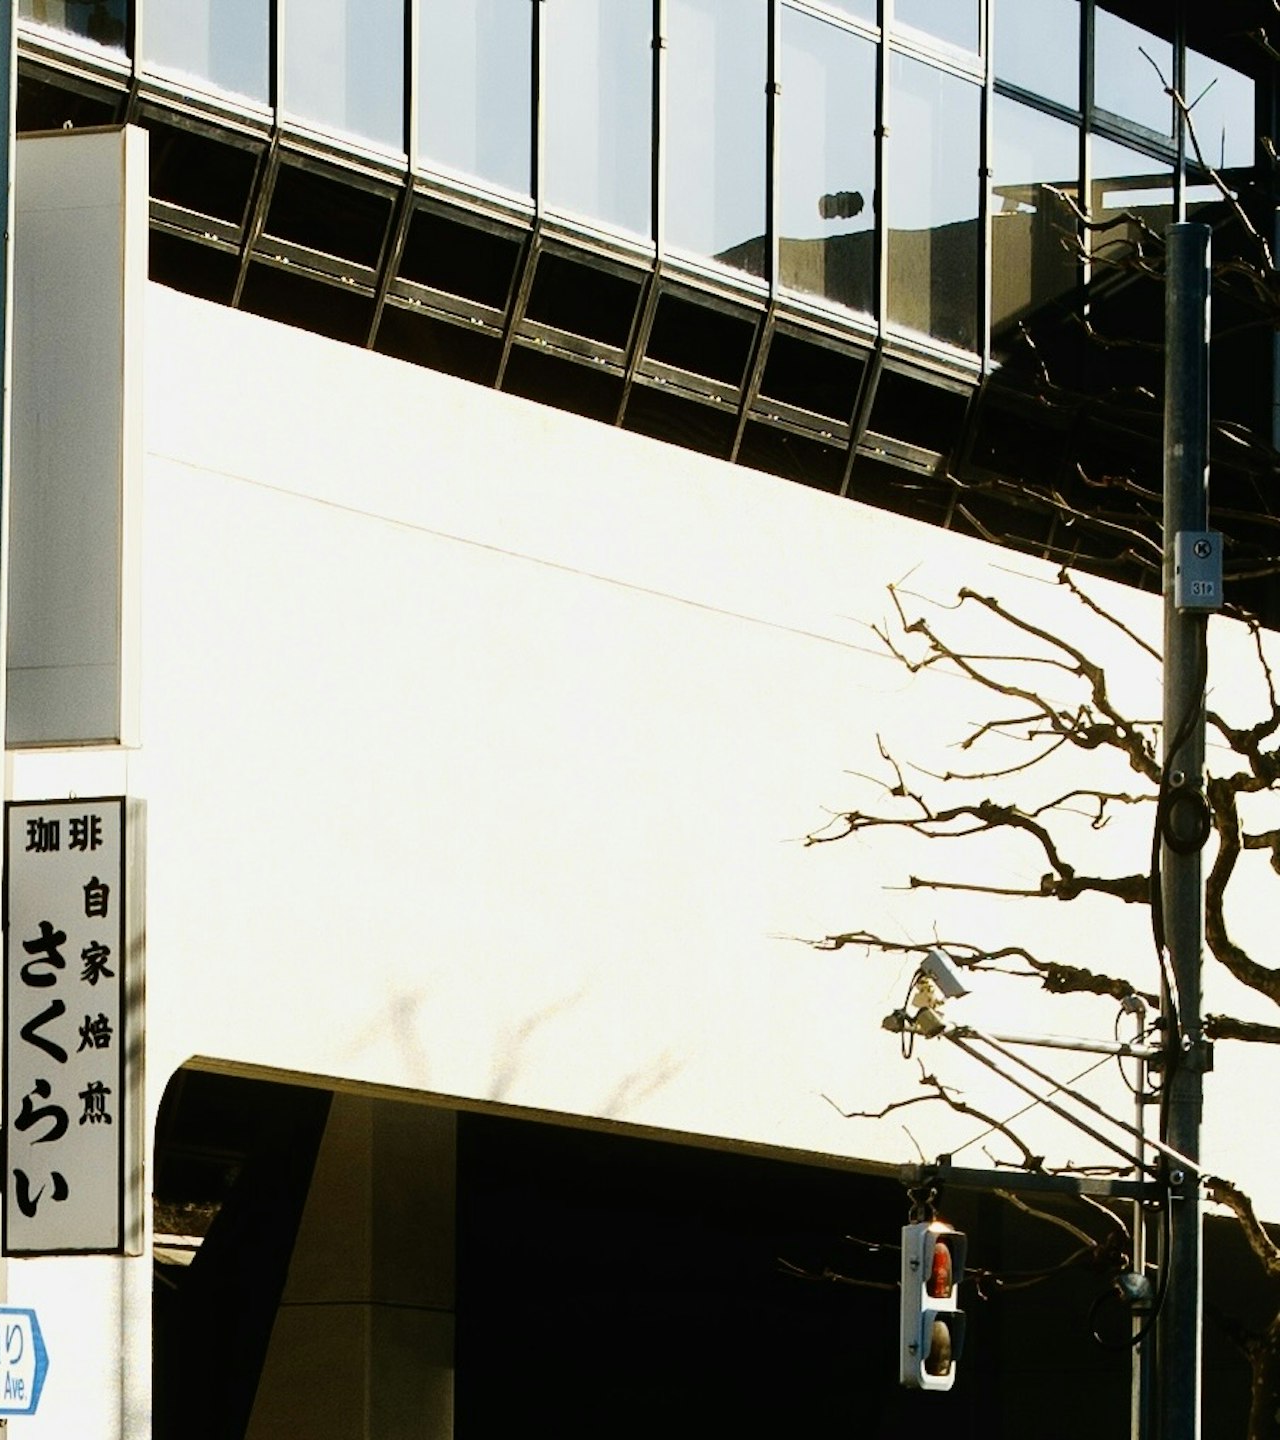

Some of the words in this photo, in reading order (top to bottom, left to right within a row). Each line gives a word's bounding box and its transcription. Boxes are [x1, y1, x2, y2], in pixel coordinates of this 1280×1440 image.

[25, 814, 104, 853] 珈琲
[13, 920, 70, 1219] さくらい
[76, 876, 115, 1126] 自家焙煎
